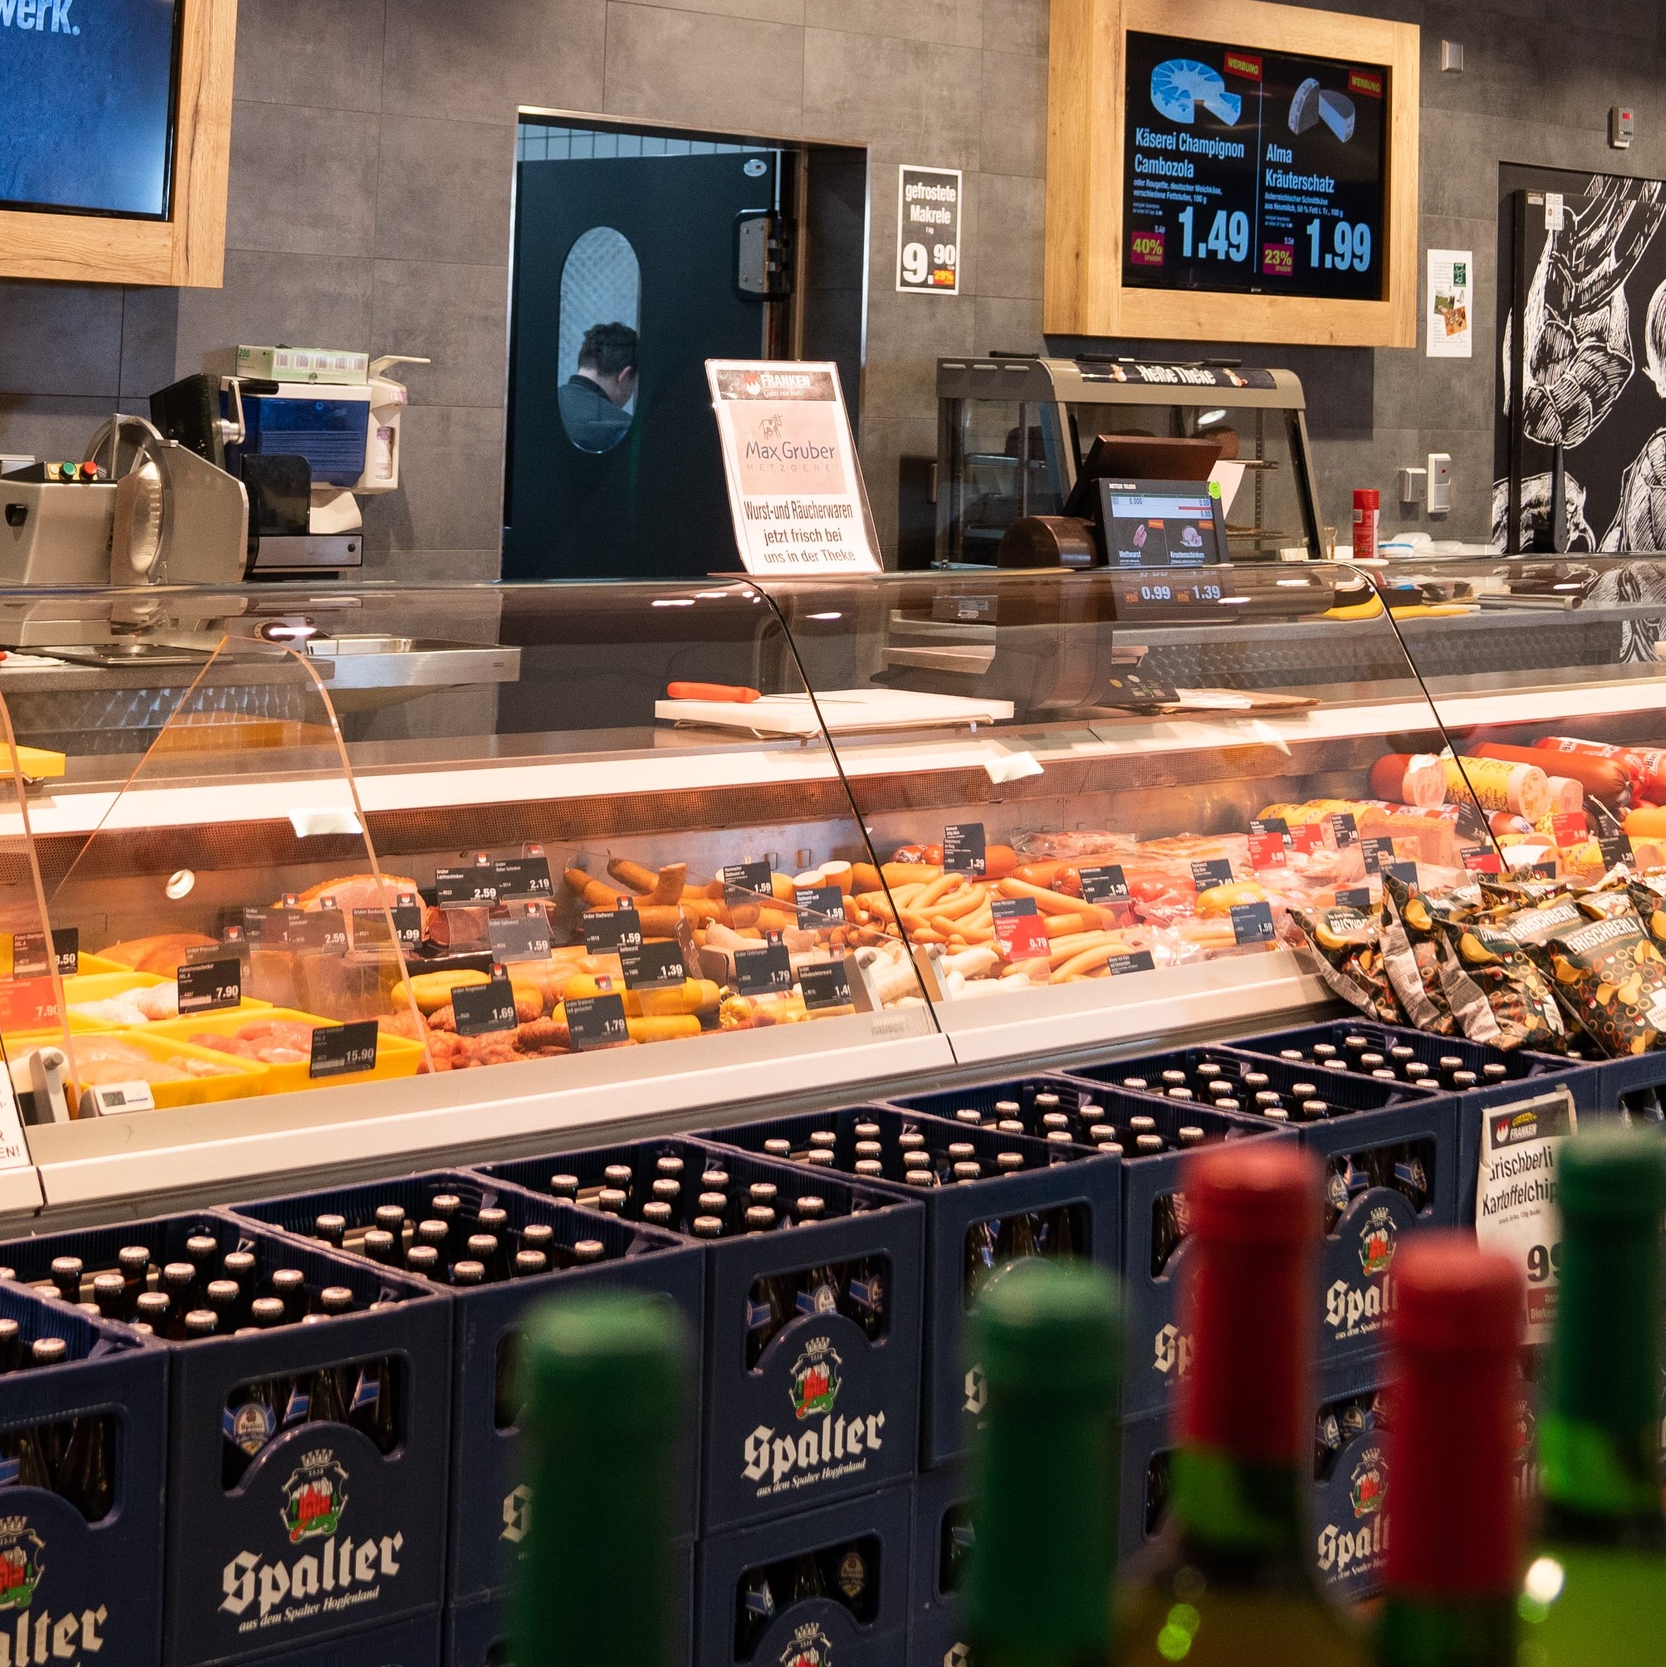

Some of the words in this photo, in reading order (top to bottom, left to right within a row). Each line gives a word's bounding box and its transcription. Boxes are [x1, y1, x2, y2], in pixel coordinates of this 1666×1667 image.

[1227, 57, 1259, 75] WERBUNG
[1135, 127, 1177, 150] Käserei
[1179, 132, 1245, 160] Champignon
[1266, 143, 1293, 164] Alma
[1134, 154, 1195, 179] Cambozola
[1265, 168, 1335, 193] Kräuterschatz
[905, 181, 957, 203] gefrostete
[910, 204, 952, 225] Makrele
[1178, 205, 1250, 263] 1.49
[1133, 237, 1163, 255] 40%
[1306, 217, 1372, 273] 1.99
[1264, 250, 1292, 266] 23%
[760, 374, 812, 388] FRANKEN
[1171, 366, 1217, 385] Theke
[746, 441, 782, 462] Max
[782, 440, 835, 460] Gruber
[744, 501, 790, 521] Wurst-und
[791, 500, 854, 520] Räucherwaren
[763, 530, 789, 547] jetzt
[791, 528, 823, 543] frisch
[826, 527, 843, 542] bei
[764, 552, 786, 563] uns
[787, 550, 799, 562] in
[801, 549, 818, 562] der
[823, 549, 856, 562] Theke
[1141, 586, 1171, 600] 0.99
[1192, 585, 1221, 599] 1.39
[473, 887, 497, 899] 2.59
[529, 878, 550, 890] 2.19
[620, 932, 641, 945] 1.59
[1566, 917, 1640, 954] GRISCHBERLI
[527, 939, 548, 952] 1.59
[661, 963, 683, 977] 1.39
[215, 984, 239, 999] 7.90
[35, 1003, 61, 1018] 7.90
[492, 1006, 514, 1021] 1.69
[604, 1019, 626, 1032] 1.79
[345, 1047, 375, 1062] 15.90
[1509, 1121, 1538, 1140] FRANKEN
[1482, 1179, 1558, 1217] Kartoffelchip
[1324, 1274, 1398, 1329] Spal
[740, 1409, 886, 1483] Spalter
[756, 1483, 772, 1498] aus
[772, 1479, 790, 1494] dem
[792, 1470, 820, 1488] Spalter
[822, 1457, 866, 1480] Hopfenland
[217, 1530, 404, 1617] Spalter
[238, 1618, 258, 1633] aus
[260, 1612, 282, 1627] dem
[284, 1602, 320, 1620] Spalter
[323, 1584, 380, 1613] Hopfenland
